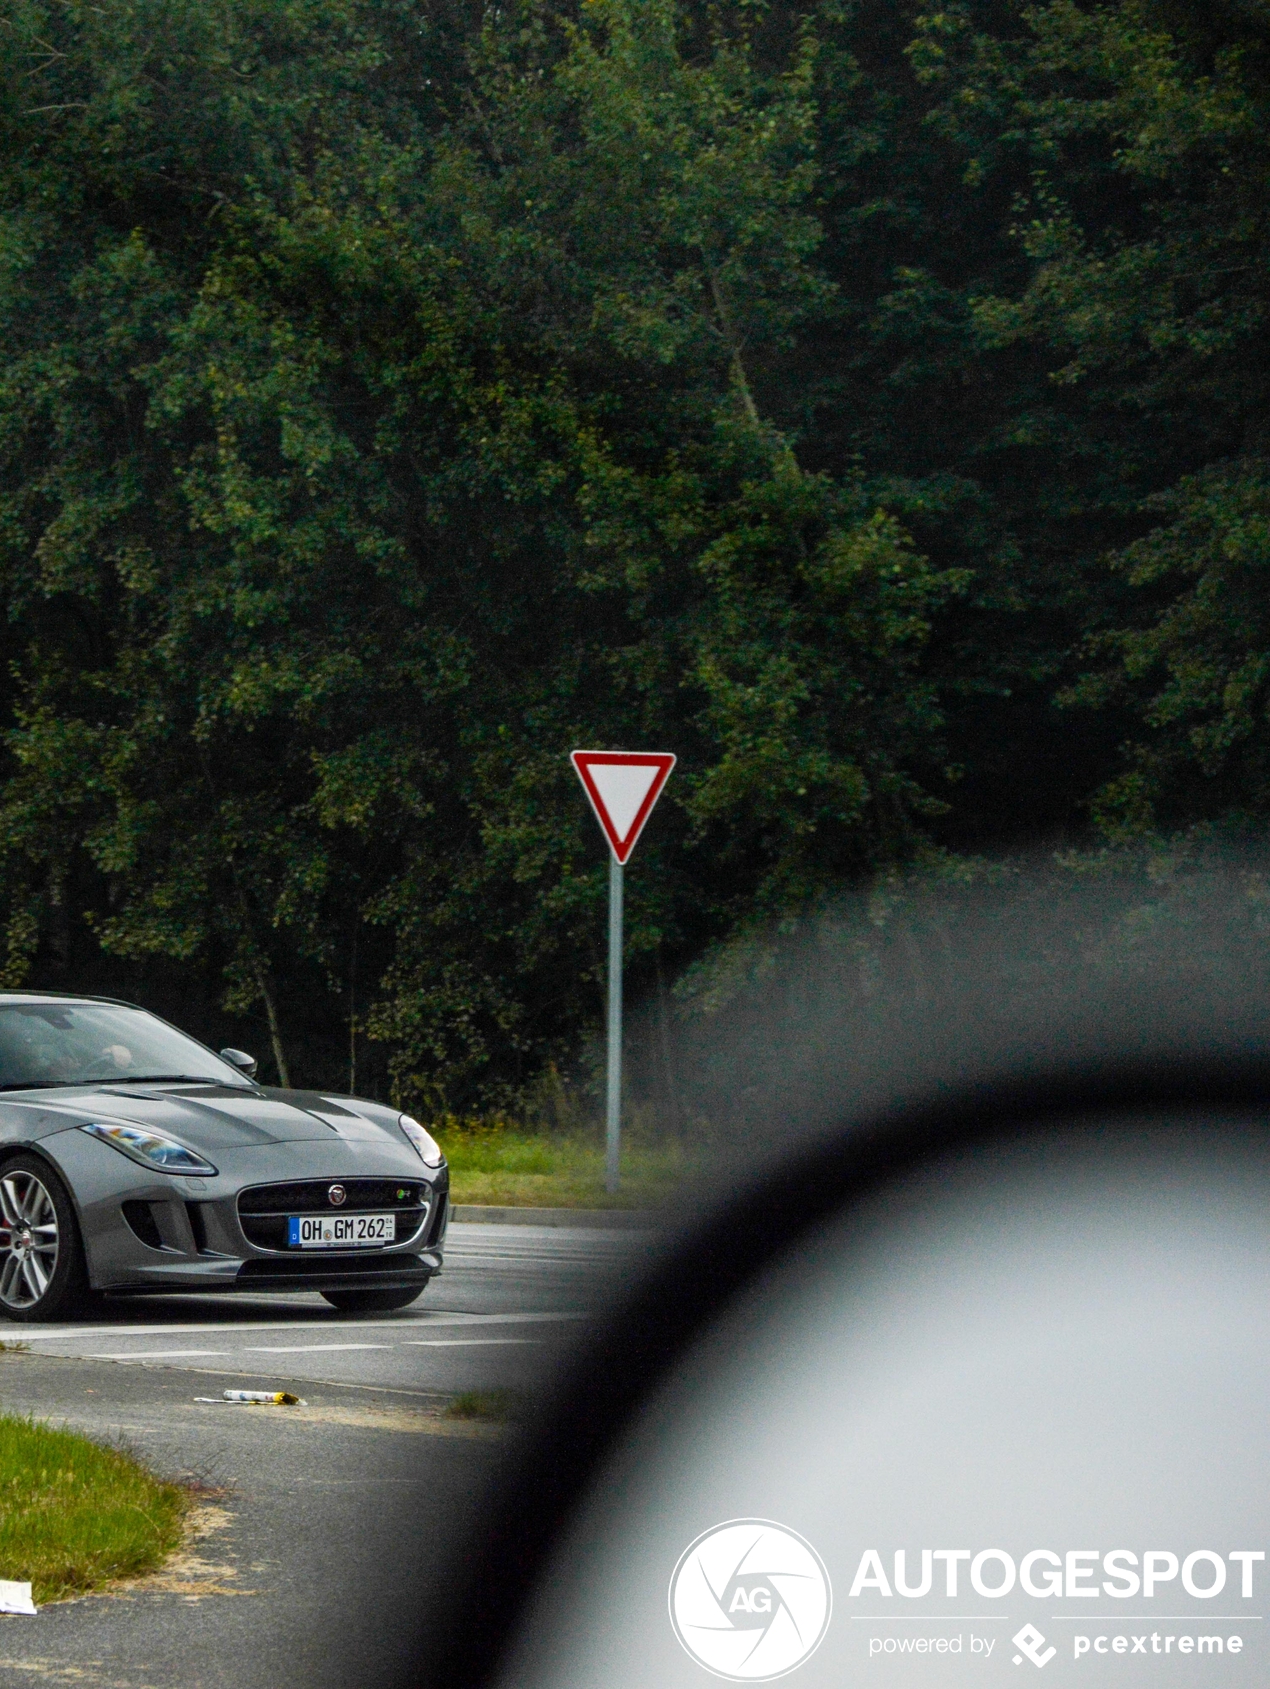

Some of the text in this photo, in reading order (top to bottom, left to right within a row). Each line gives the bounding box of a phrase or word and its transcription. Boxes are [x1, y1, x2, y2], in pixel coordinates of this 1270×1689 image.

[301, 1218, 385, 1240] OH GM 262
